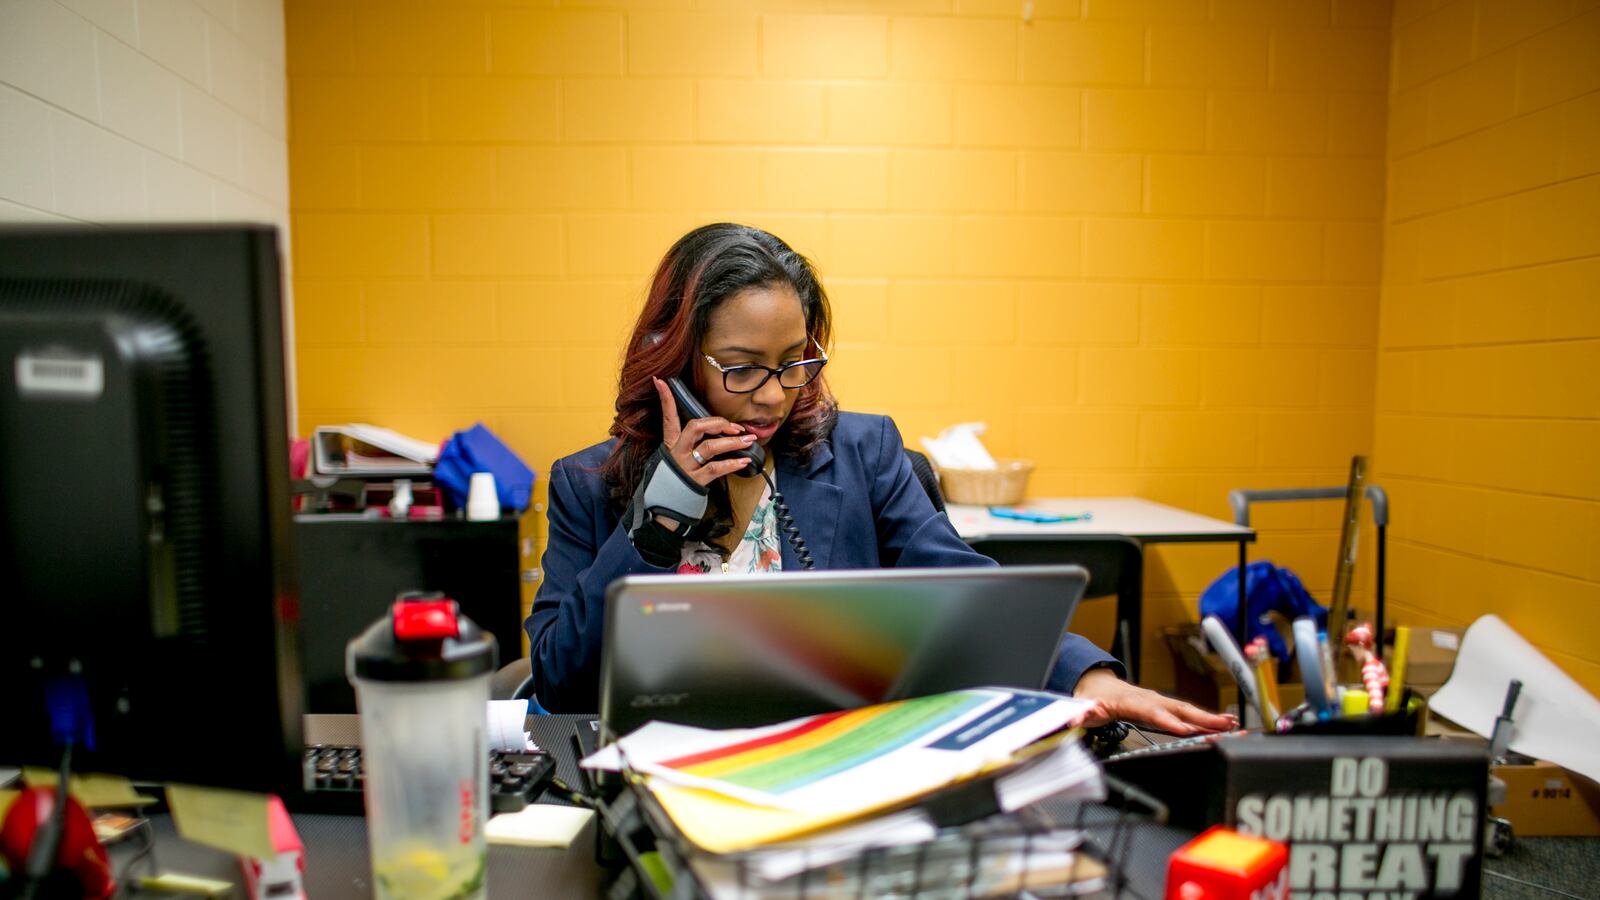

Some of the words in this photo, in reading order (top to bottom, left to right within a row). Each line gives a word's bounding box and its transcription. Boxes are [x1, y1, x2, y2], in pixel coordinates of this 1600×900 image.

[630, 693, 689, 707] acer
[1331, 757, 1387, 797] DO
[1236, 796, 1476, 842] SOMETHING
[1289, 843, 1476, 891] REAT
